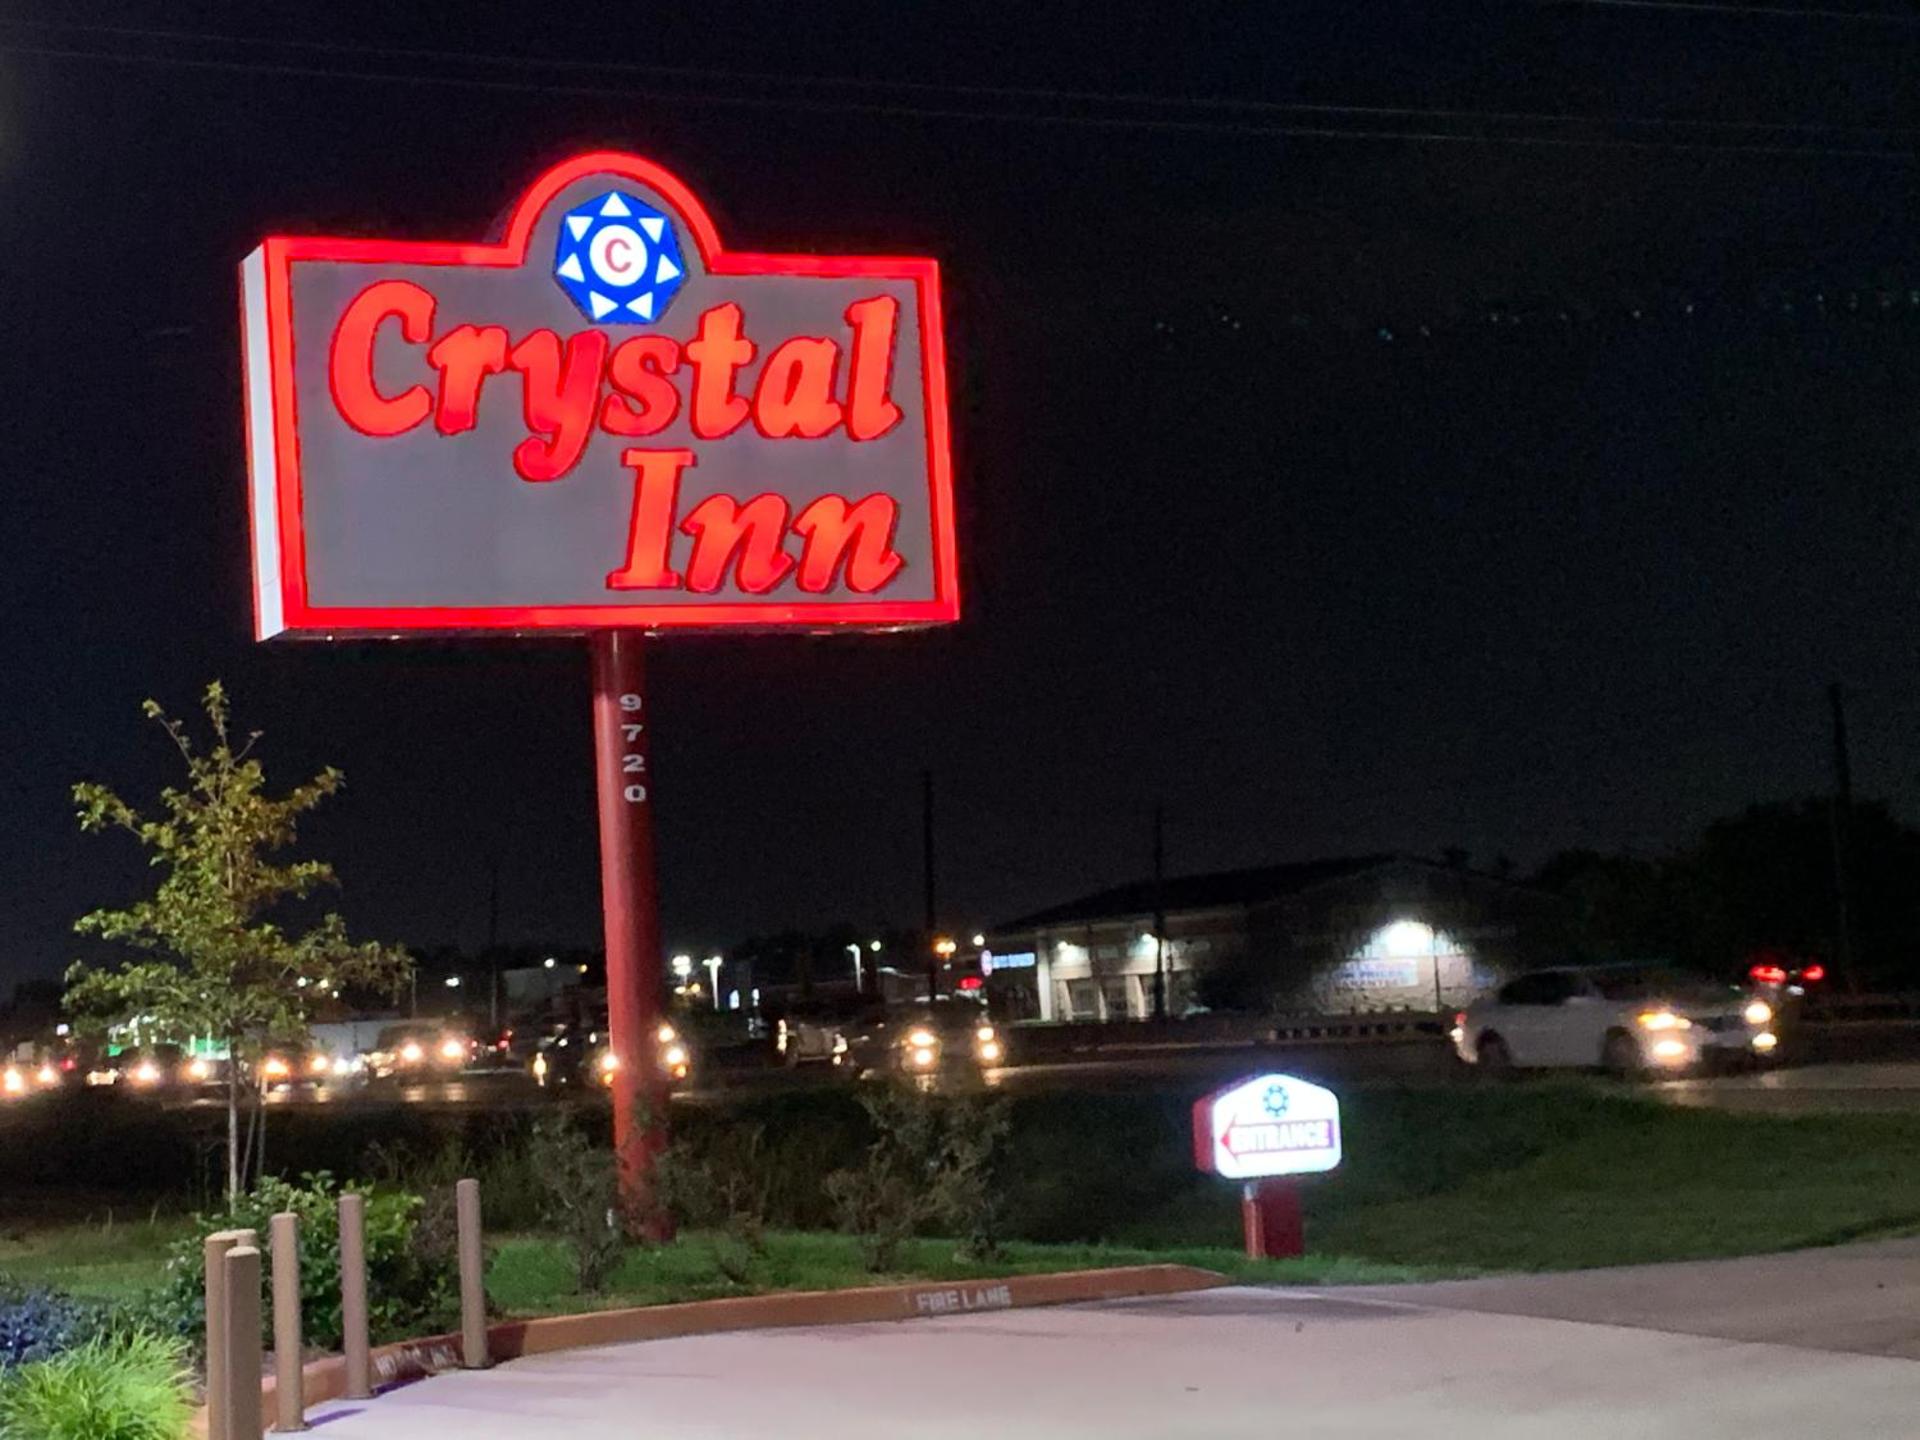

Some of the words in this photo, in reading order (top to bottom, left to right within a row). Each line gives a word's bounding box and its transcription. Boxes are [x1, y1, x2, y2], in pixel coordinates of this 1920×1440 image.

[604, 237, 632, 273] C
[329, 279, 904, 482] Crystal
[606, 448, 906, 594] Inn
[619, 693, 647, 803] 9720
[1231, 1120, 1329, 1153] ENTRANCE
[961, 1285, 1012, 1310] LANE
